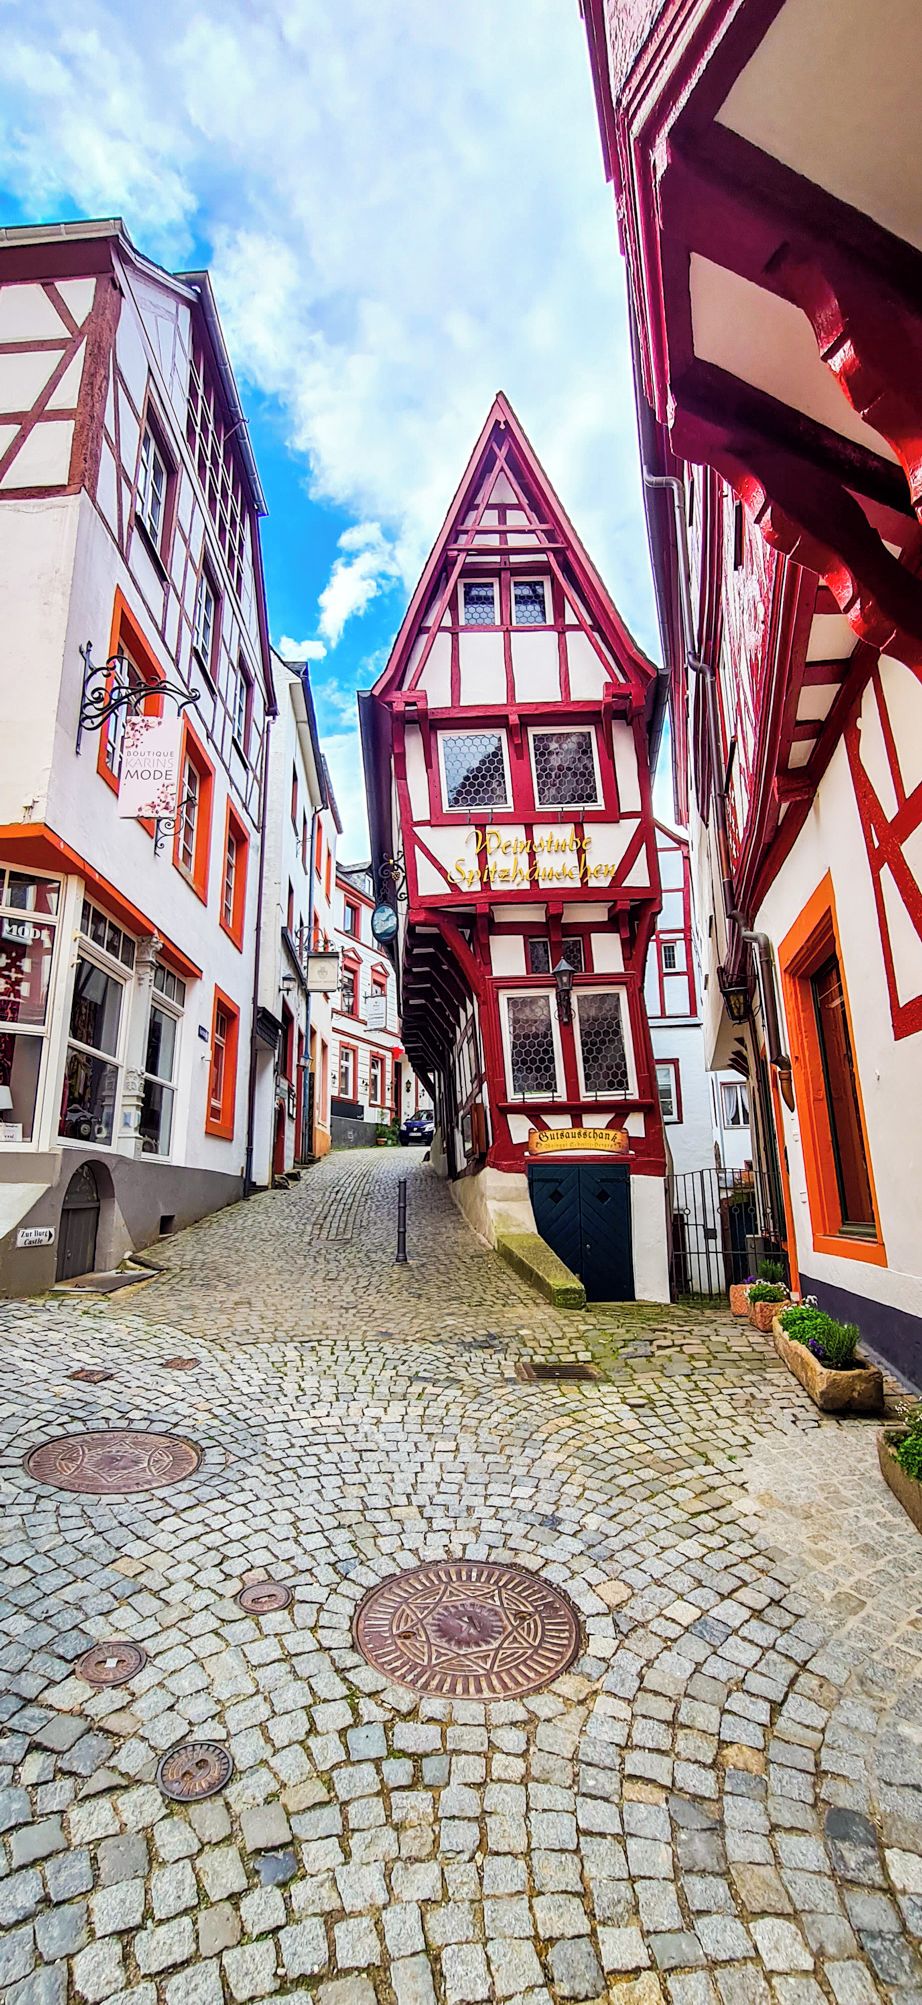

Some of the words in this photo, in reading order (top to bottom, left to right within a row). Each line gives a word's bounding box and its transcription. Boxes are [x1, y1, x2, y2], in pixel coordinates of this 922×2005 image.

[125, 757, 174, 768] KARINS
[124, 769, 173, 780] MODE
[464, 826, 593, 856] Weinstube
[447, 853, 617, 888] Spitzhäuschen
[538, 1129, 618, 1142] Gutsausschank
[20, 1230, 33, 1238] Zur
